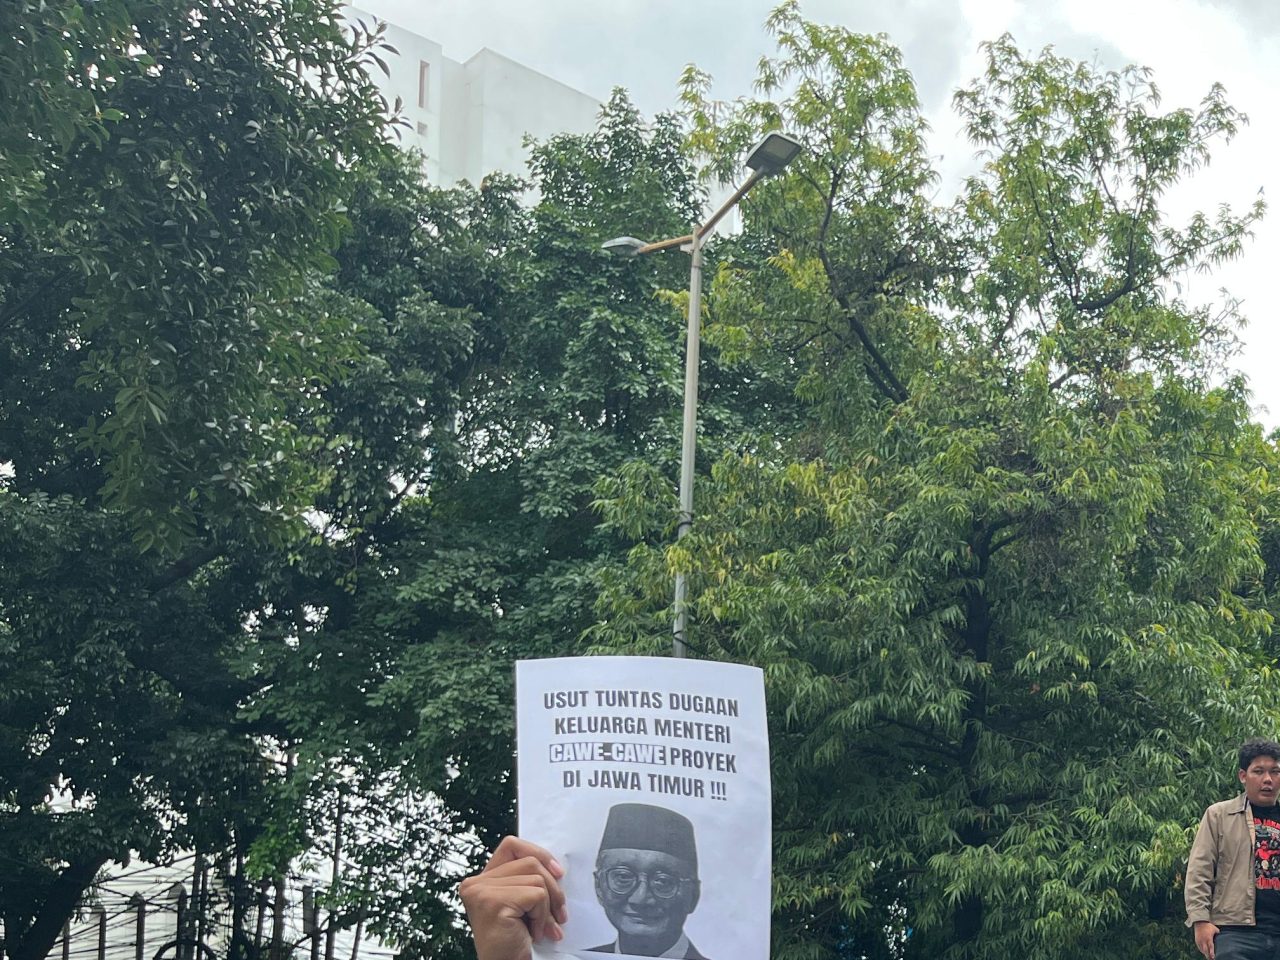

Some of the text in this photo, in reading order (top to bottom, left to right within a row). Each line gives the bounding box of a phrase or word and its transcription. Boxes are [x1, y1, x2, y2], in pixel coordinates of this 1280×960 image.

[544, 690, 738, 717] USUT TUNTAS DUGAAN
[554, 717, 731, 744] KELUARGA MENTERI
[550, 743, 737, 773] CAWE-CAWE PROYEK
[563, 770, 727, 801] DI JAWA TIMUR !!!
